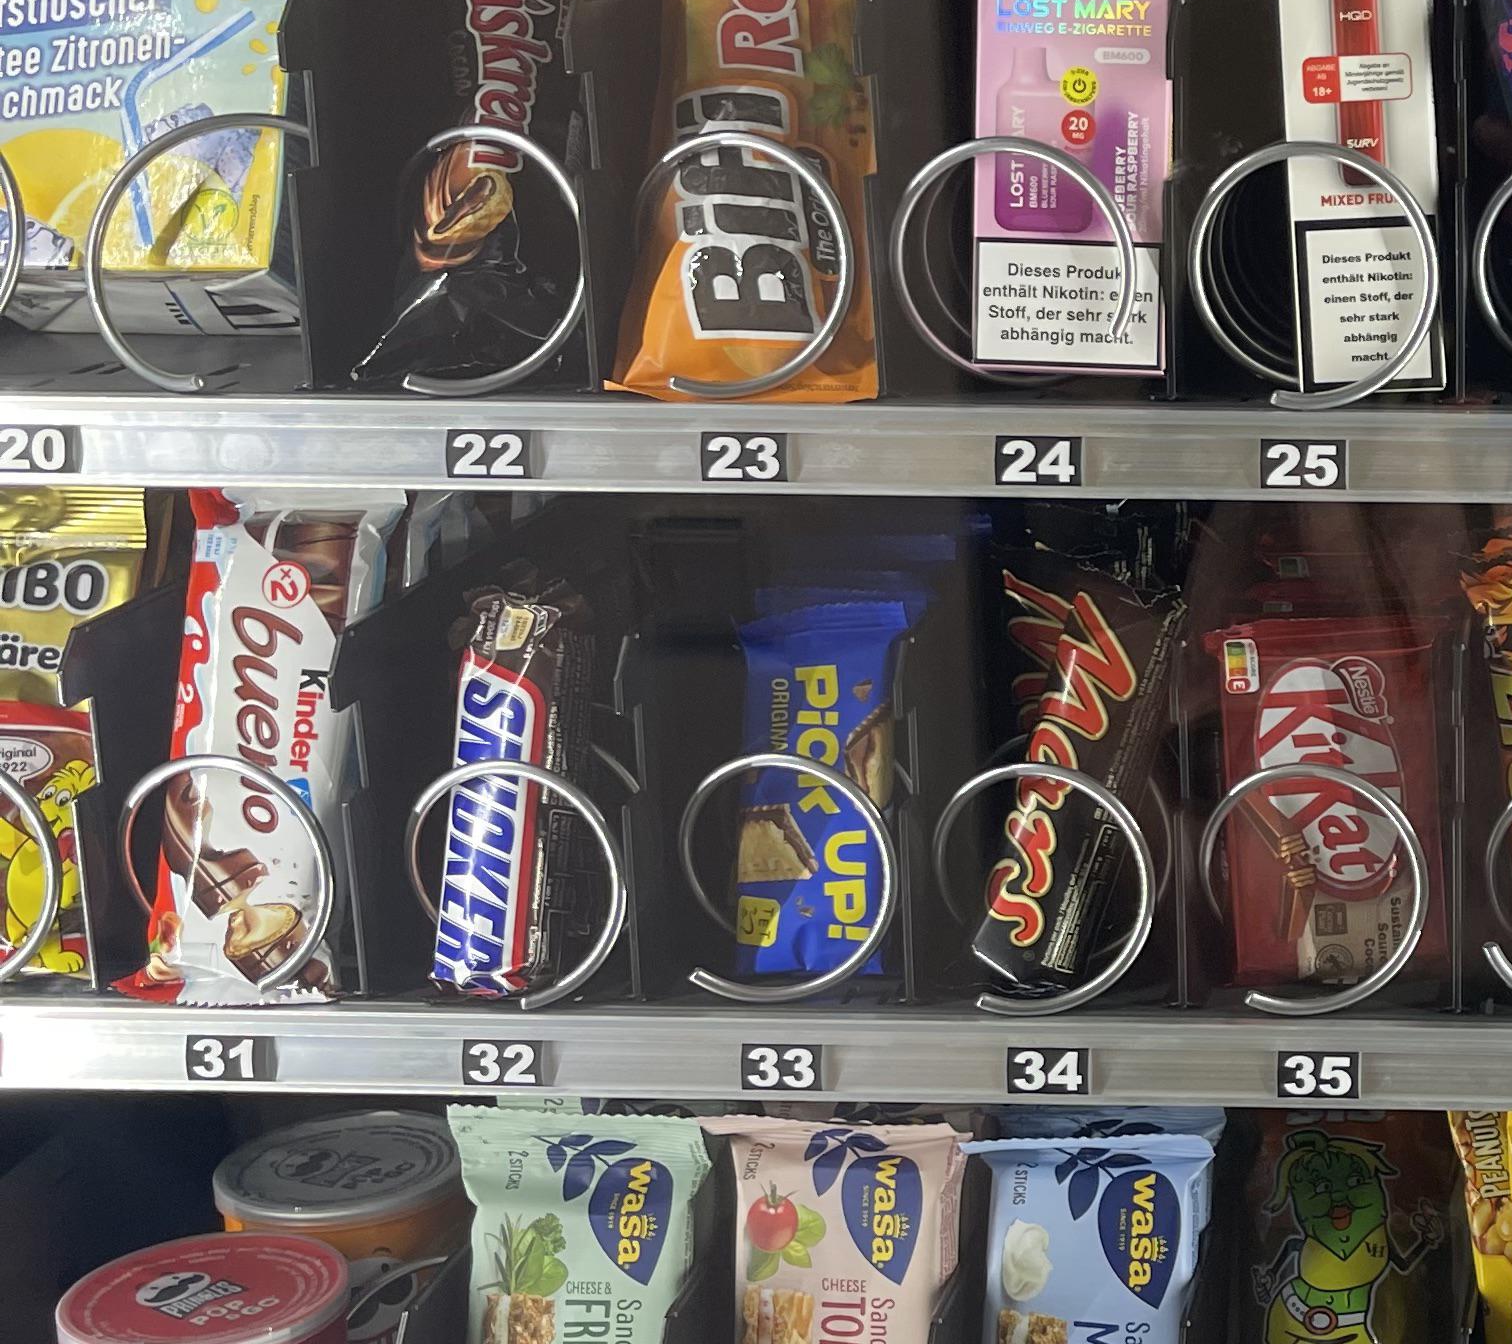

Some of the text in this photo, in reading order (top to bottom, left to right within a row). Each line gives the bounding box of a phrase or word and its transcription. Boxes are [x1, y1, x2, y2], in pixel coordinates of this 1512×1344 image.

[1058, 22, 1152, 37] E-ZIGARETTE
[1339, 10, 1373, 22] HQD
[51, 32, 187, 67] Zitronen-
[1067, 116, 1090, 131] 20
[1346, 138, 1379, 149] SURV
[1010, 159, 1025, 208] LOST
[1320, 194, 1365, 207] MIXED
[1008, 262, 1061, 278] Dieses
[983, 284, 1105, 301] enthält Nikotin:
[988, 304, 1101, 322] Stoff, der sehr
[1000, 326, 1075, 346] abhängig
[0, 427, 66, 471] 20
[452, 433, 524, 476] 22
[706, 436, 780, 480] 23
[1001, 439, 1075, 483] 24
[1266, 443, 1339, 487] 25
[1346, 665, 1379, 714] Nestlé
[231, 606, 303, 834] bueno
[434, 671, 528, 979] SNICKERS
[823, 828, 871, 942] UP!
[192, 1038, 254, 1079] 31
[468, 1042, 536, 1084] 32
[747, 1047, 815, 1088] 33
[1013, 1050, 1083, 1091] 34
[1283, 1055, 1352, 1096] 35
[505, 1158, 523, 1190] STICKS
[744, 1148, 764, 1181] STICKS
[1012, 1169, 1029, 1206] STICKS
[618, 1160, 653, 1266] wasa
[872, 1157, 903, 1264] wasa
[1128, 1173, 1157, 1289] wasa
[160, 1280, 244, 1318] PRINGLES
[566, 1281, 603, 1295] CHEESE
[821, 1277, 867, 1293] CHEESE
